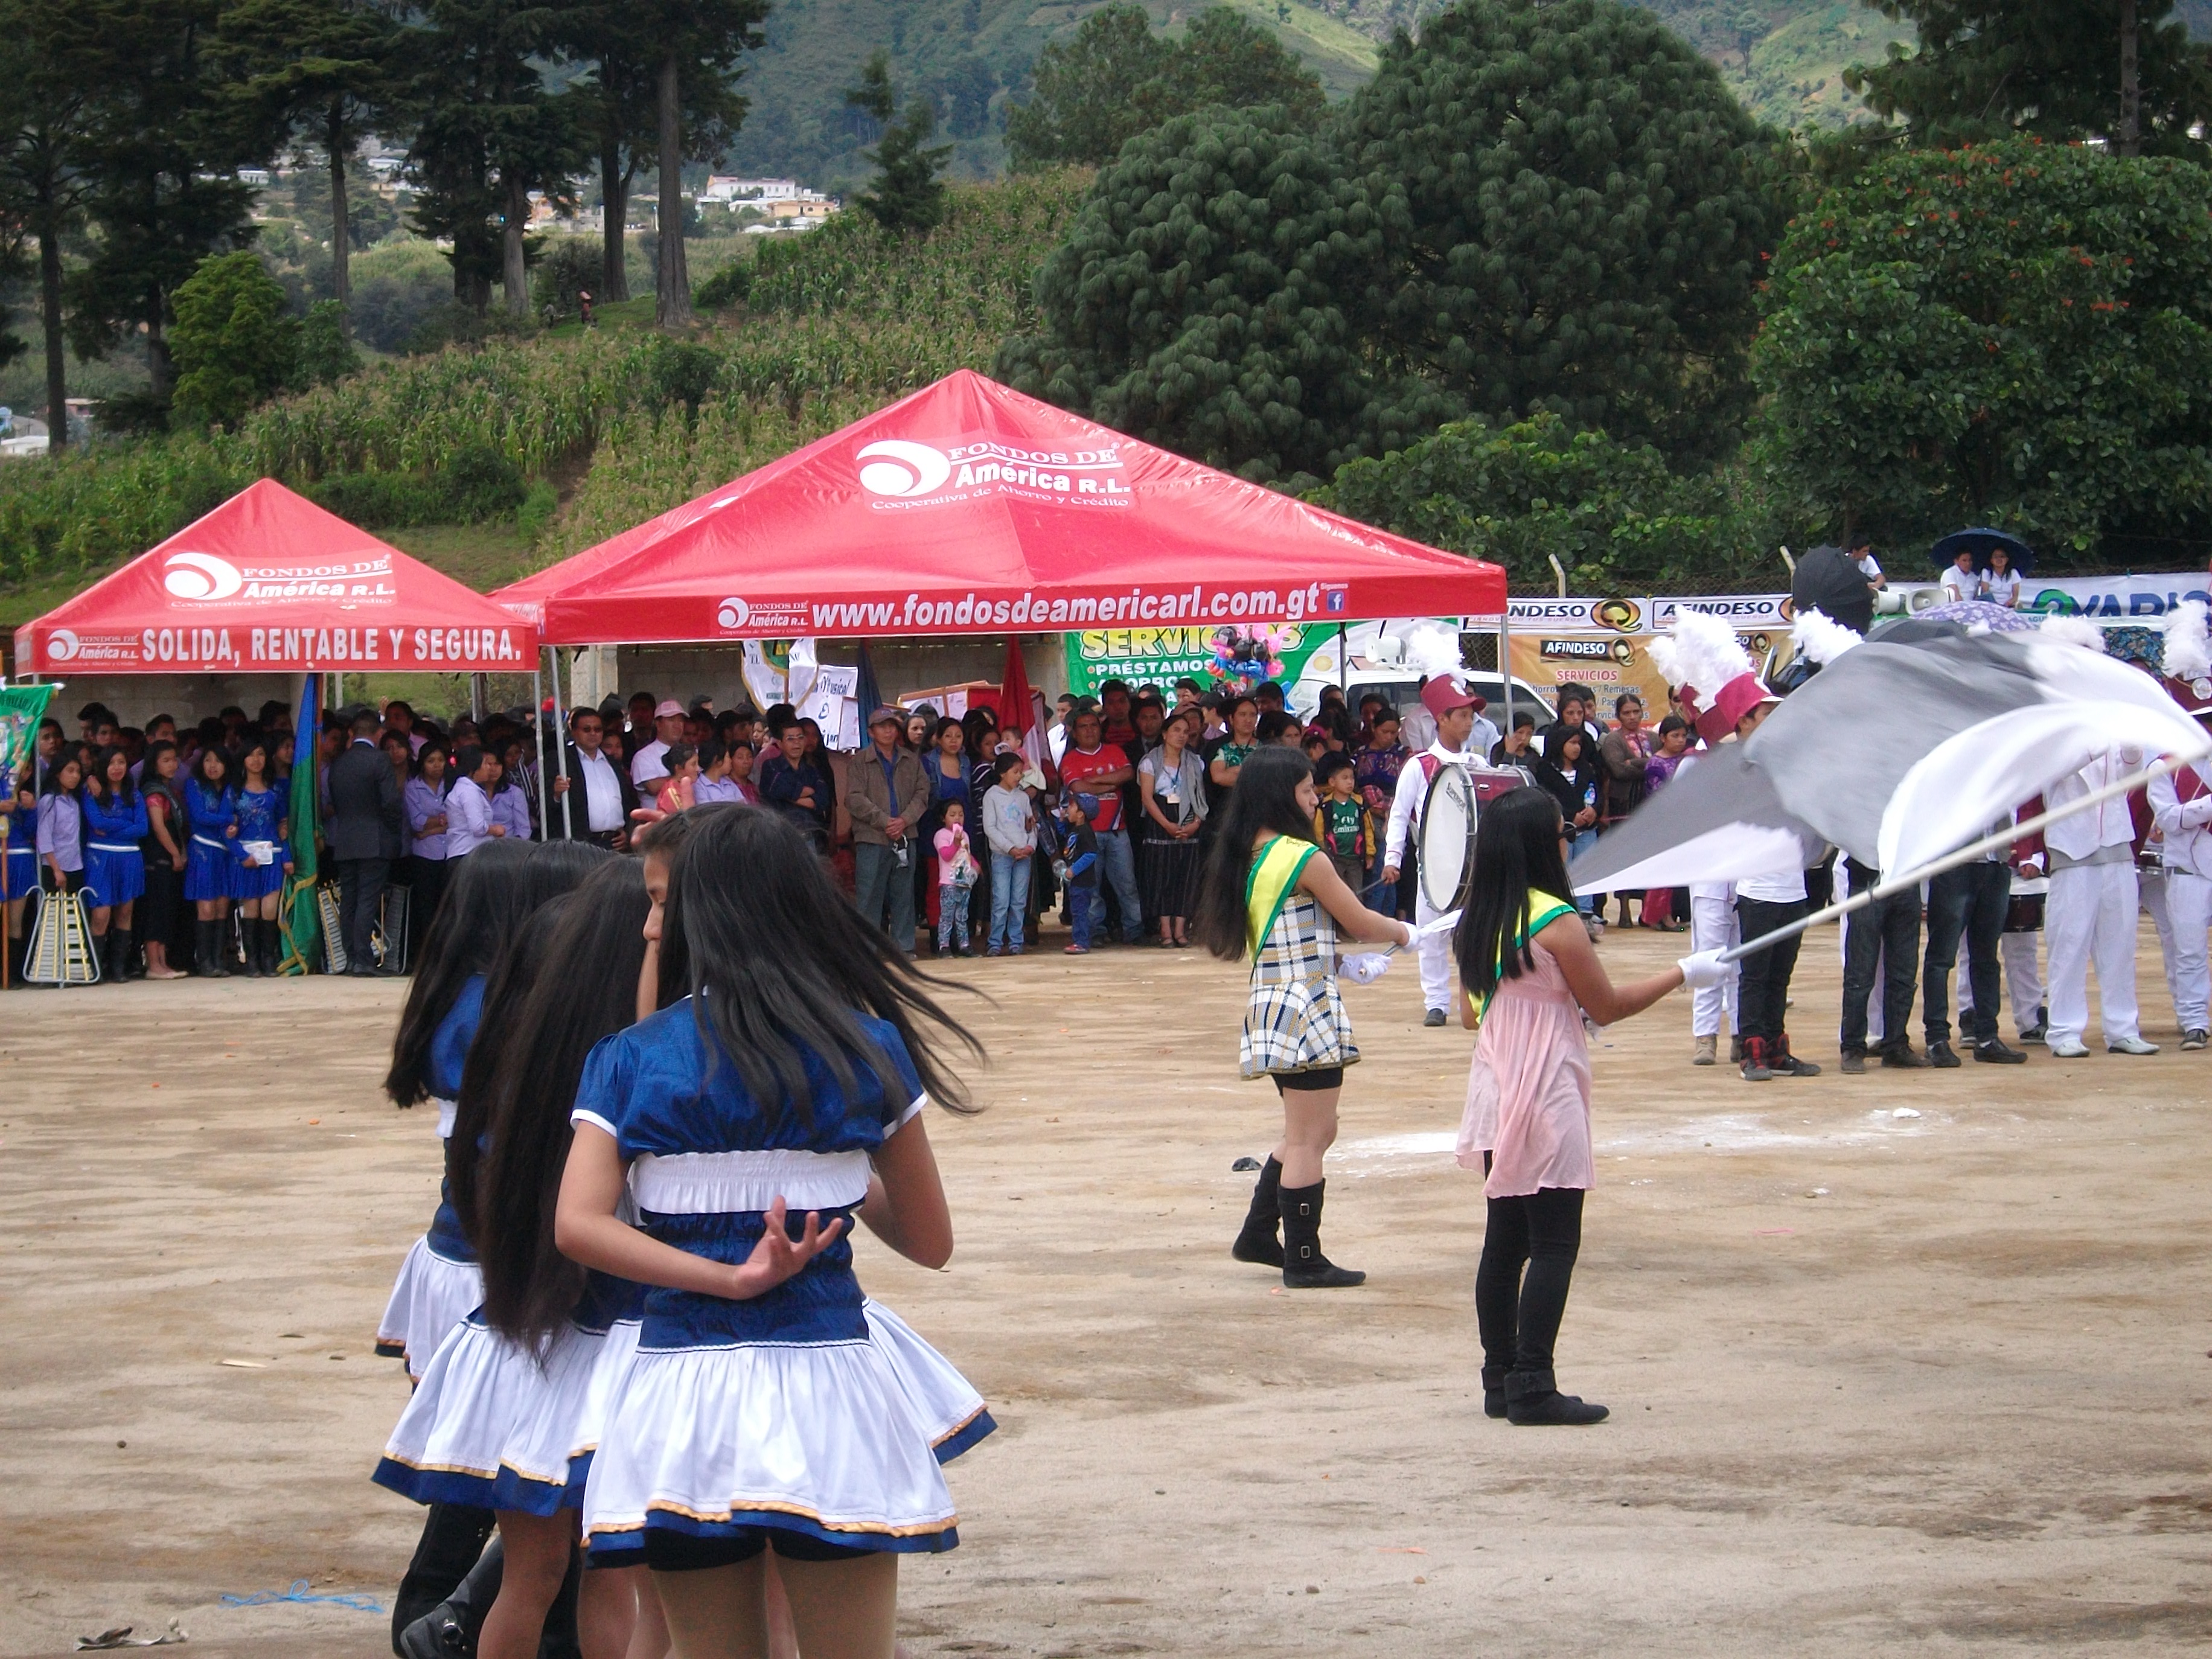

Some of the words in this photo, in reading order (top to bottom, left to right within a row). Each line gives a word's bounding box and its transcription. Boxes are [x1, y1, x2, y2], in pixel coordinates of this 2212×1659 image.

[947, 441, 1069, 464] FONDOS
[1076, 448, 1118, 464] DE
[955, 462, 1070, 491] América
[1078, 478, 1131, 494] R.L.
[872, 493, 967, 510] Cooperativa
[973, 487, 992, 497] de
[997, 484, 1052, 500] Ahorro
[1056, 495, 1066, 504] y
[1070, 495, 1129, 507] Crédito
[243, 565, 347, 578] FONDOS
[354, 559, 388, 574] DE
[243, 580, 345, 598] América
[351, 583, 395, 596] R.L.
[171, 600, 252, 609] Cooperativa
[812, 581, 1319, 628] www.fondosdeamericarl.com.gt
[1509, 605, 1586, 617] NDESO
[1662, 602, 1774, 616] AINDESO
[748, 613, 789, 627] América
[790, 616, 808, 626] R.L.
[78, 646, 120, 659] América
[142, 628, 240, 668] SOLIDA,
[252, 628, 378, 660] RENTABLE
[389, 628, 404, 660] Y
[414, 628, 521, 661] SEGURA.
[1545, 642, 1606, 654] AFINDESO
[1556, 671, 1618, 681] SERVICIOS
[1604, 685, 1641, 694] Remesas.
[1446, 781, 1466, 809] SUPERIOR
